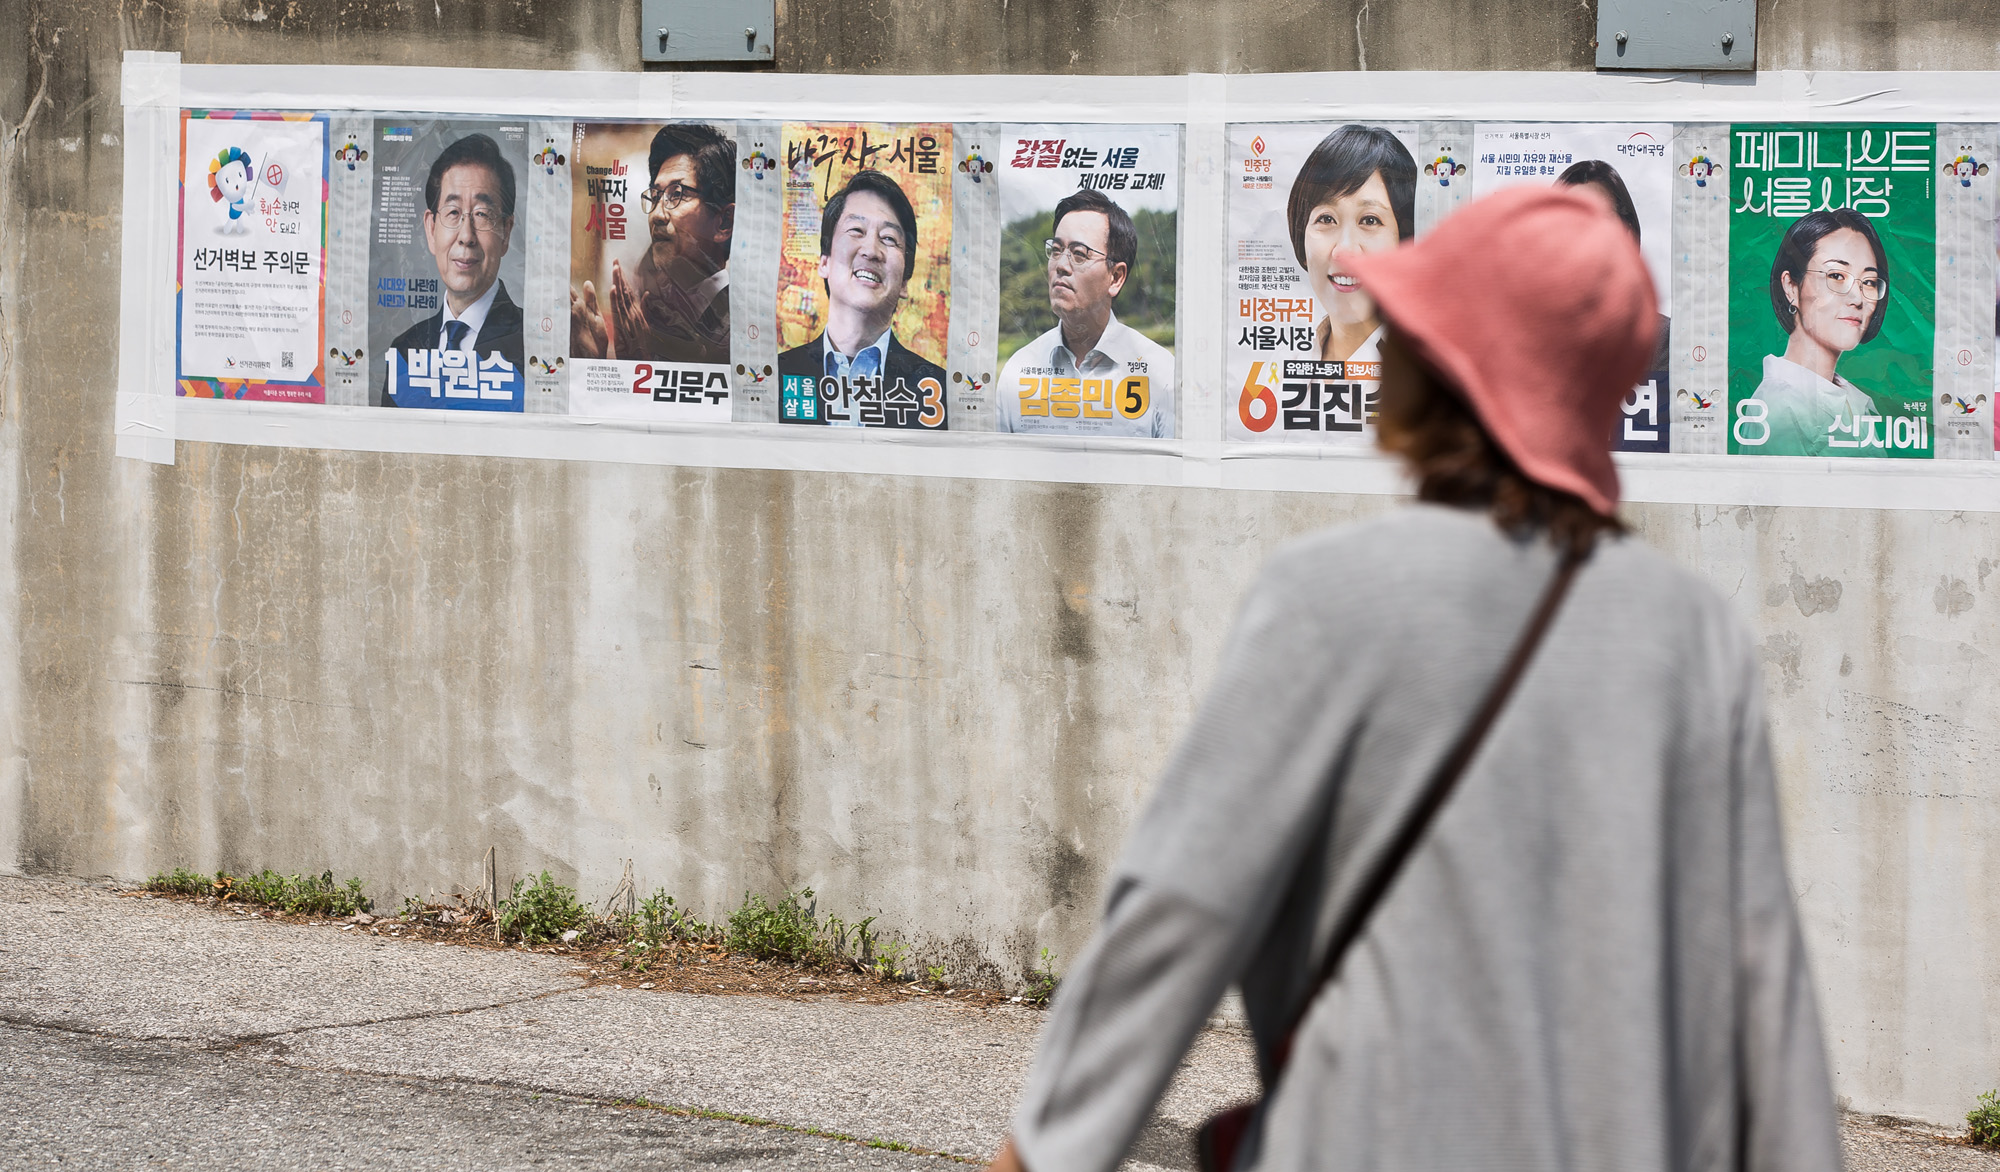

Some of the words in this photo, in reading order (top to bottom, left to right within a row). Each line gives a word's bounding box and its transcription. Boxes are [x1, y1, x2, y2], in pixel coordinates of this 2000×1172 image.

[1508, 132, 1540, 140] 서울특별시장
[1540, 132, 1551, 140] 선거
[1101, 147, 1139, 169] 서울
[1480, 153, 1496, 164] 서울
[1498, 153, 1521, 165] 시민의
[1523, 153, 1546, 164] 자유와
[1549, 153, 1573, 165] 재산을
[1617, 144, 1665, 157] 대한애국당
[1735, 130, 1931, 172] 페미니스트
[1244, 159, 1272, 172] 민중당
[1496, 166, 1511, 176] 지킬
[1514, 166, 1537, 176] 유일한
[1539, 166, 1555, 176] 후보
[587, 178, 627, 203] 바꾸자
[1077, 173, 1129, 190] 제1야당
[1130, 173, 1166, 190] 교체!
[260, 197, 299, 215] 훼손하면
[1735, 176, 1893, 218] 서울시장
[266, 218, 277, 233] 안
[280, 222, 300, 234] 돼요!
[585, 203, 627, 240] 서울
[193, 248, 257, 272] 선거벽보
[263, 251, 310, 274] 주의문
[1261, 266, 1277, 274] 조현민
[1279, 266, 1295, 274] 고발자
[377, 277, 406, 292] 시대와
[408, 278, 438, 293] 나란히
[1239, 274, 1260, 282] 최저임금
[377, 294, 406, 308] 시민과
[408, 295, 438, 309] 나란히
[1240, 297, 1314, 323] 비정규직
[1238, 325, 1315, 351] 서울시장
[385, 347, 397, 395] 1
[407, 348, 514, 400] 박원순
[1020, 367, 1052, 376] 서울특별시장
[1054, 368, 1065, 376] 후보
[1127, 361, 1148, 373] 정의당
[1286, 362, 1314, 375] 유일한
[1315, 363, 1343, 376] 노동자
[633, 363, 653, 394] 2
[653, 369, 729, 405] 김문수
[785, 378, 815, 397] 서울
[819, 375, 919, 424] 안철수
[918, 377, 946, 427] 3
[1018, 378, 1113, 418] 김종민
[1124, 381, 1142, 413] 5
[1238, 361, 1278, 432] 6
[785, 399, 815, 418] 살림
[1903, 401, 1927, 412] 녹색당
[1733, 398, 1771, 446] 8
[1828, 415, 1928, 449] 신지예
